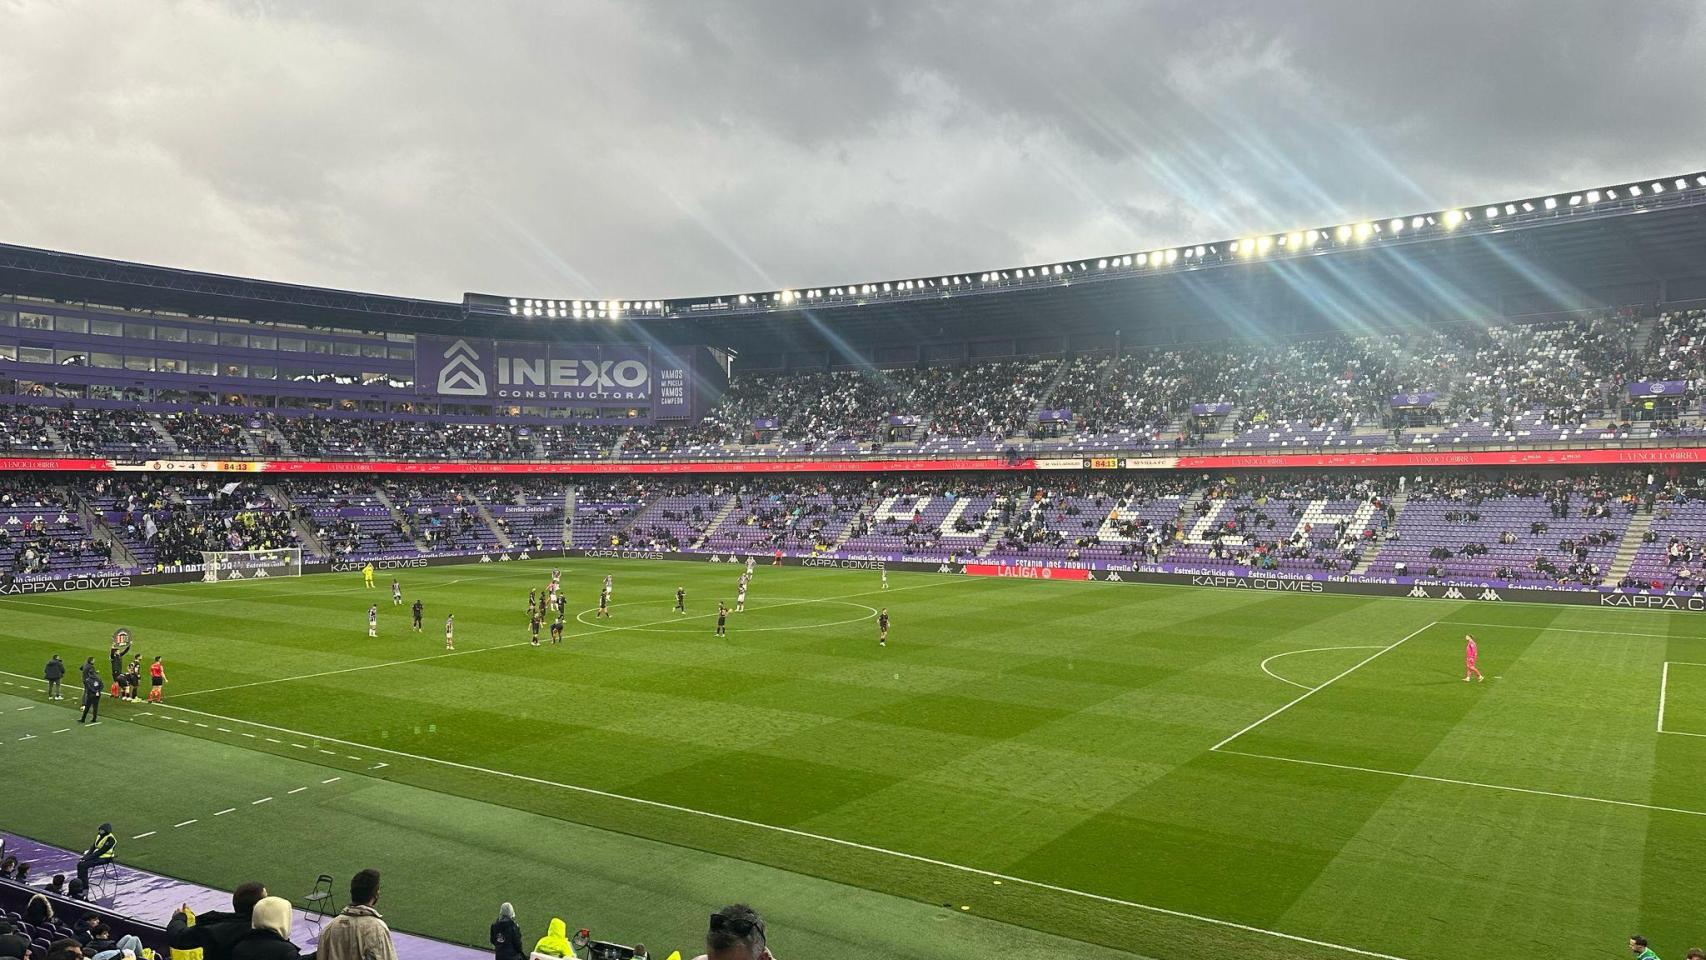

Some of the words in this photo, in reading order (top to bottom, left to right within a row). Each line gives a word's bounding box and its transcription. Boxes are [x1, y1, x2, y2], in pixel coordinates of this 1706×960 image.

[498, 357, 648, 387] INEXO
[661, 370, 682, 379] VAMOS
[498, 390, 645, 399] CONSTRUCTORA
[661, 388, 682, 397] VAMOS
[330, 559, 428, 572] KAPP.COM/ES
[802, 559, 885, 570] KAPPA.COM/ES
[1106, 564, 1131, 572] Estrella
[998, 566, 1038, 578] LALIGA
[1174, 567, 1200, 575] Estrella
[1247, 571, 1276, 579] Estrella
[1277, 572, 1304, 580] Galicia
[1192, 576, 1323, 592] KAPPA.COM/ES
[1358, 576, 1387, 584] Galicia
